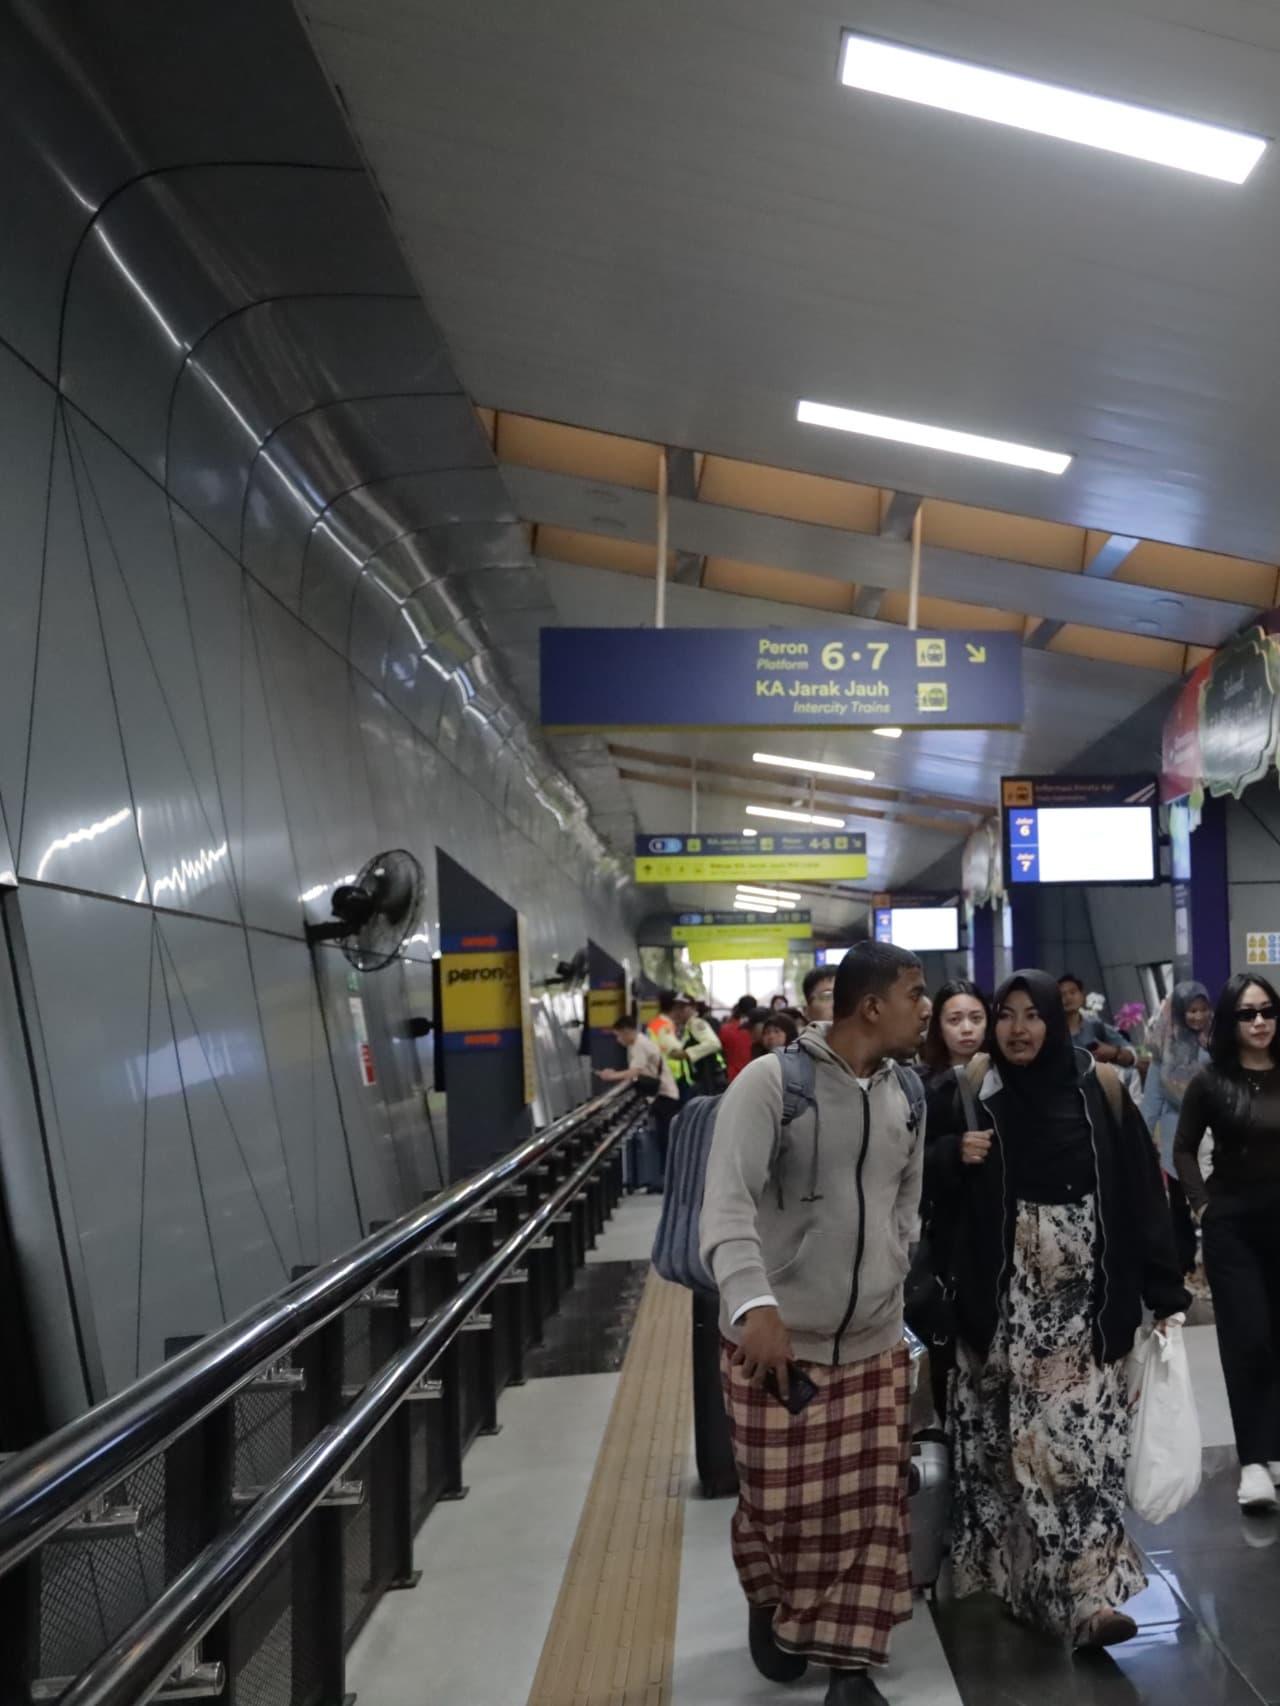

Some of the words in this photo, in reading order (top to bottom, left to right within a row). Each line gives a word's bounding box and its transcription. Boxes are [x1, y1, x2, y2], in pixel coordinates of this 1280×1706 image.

[759, 639, 808, 655] Peron
[756, 658, 808, 671] Platform
[756, 680, 785, 697] KA
[789, 680, 840, 697] Jarak
[844, 680, 890, 697] Jauh
[793, 701, 848, 716] Intercity
[851, 701, 891, 714] Trains
[1019, 825, 1031, 837] 6
[1020, 861, 1031, 873] 7
